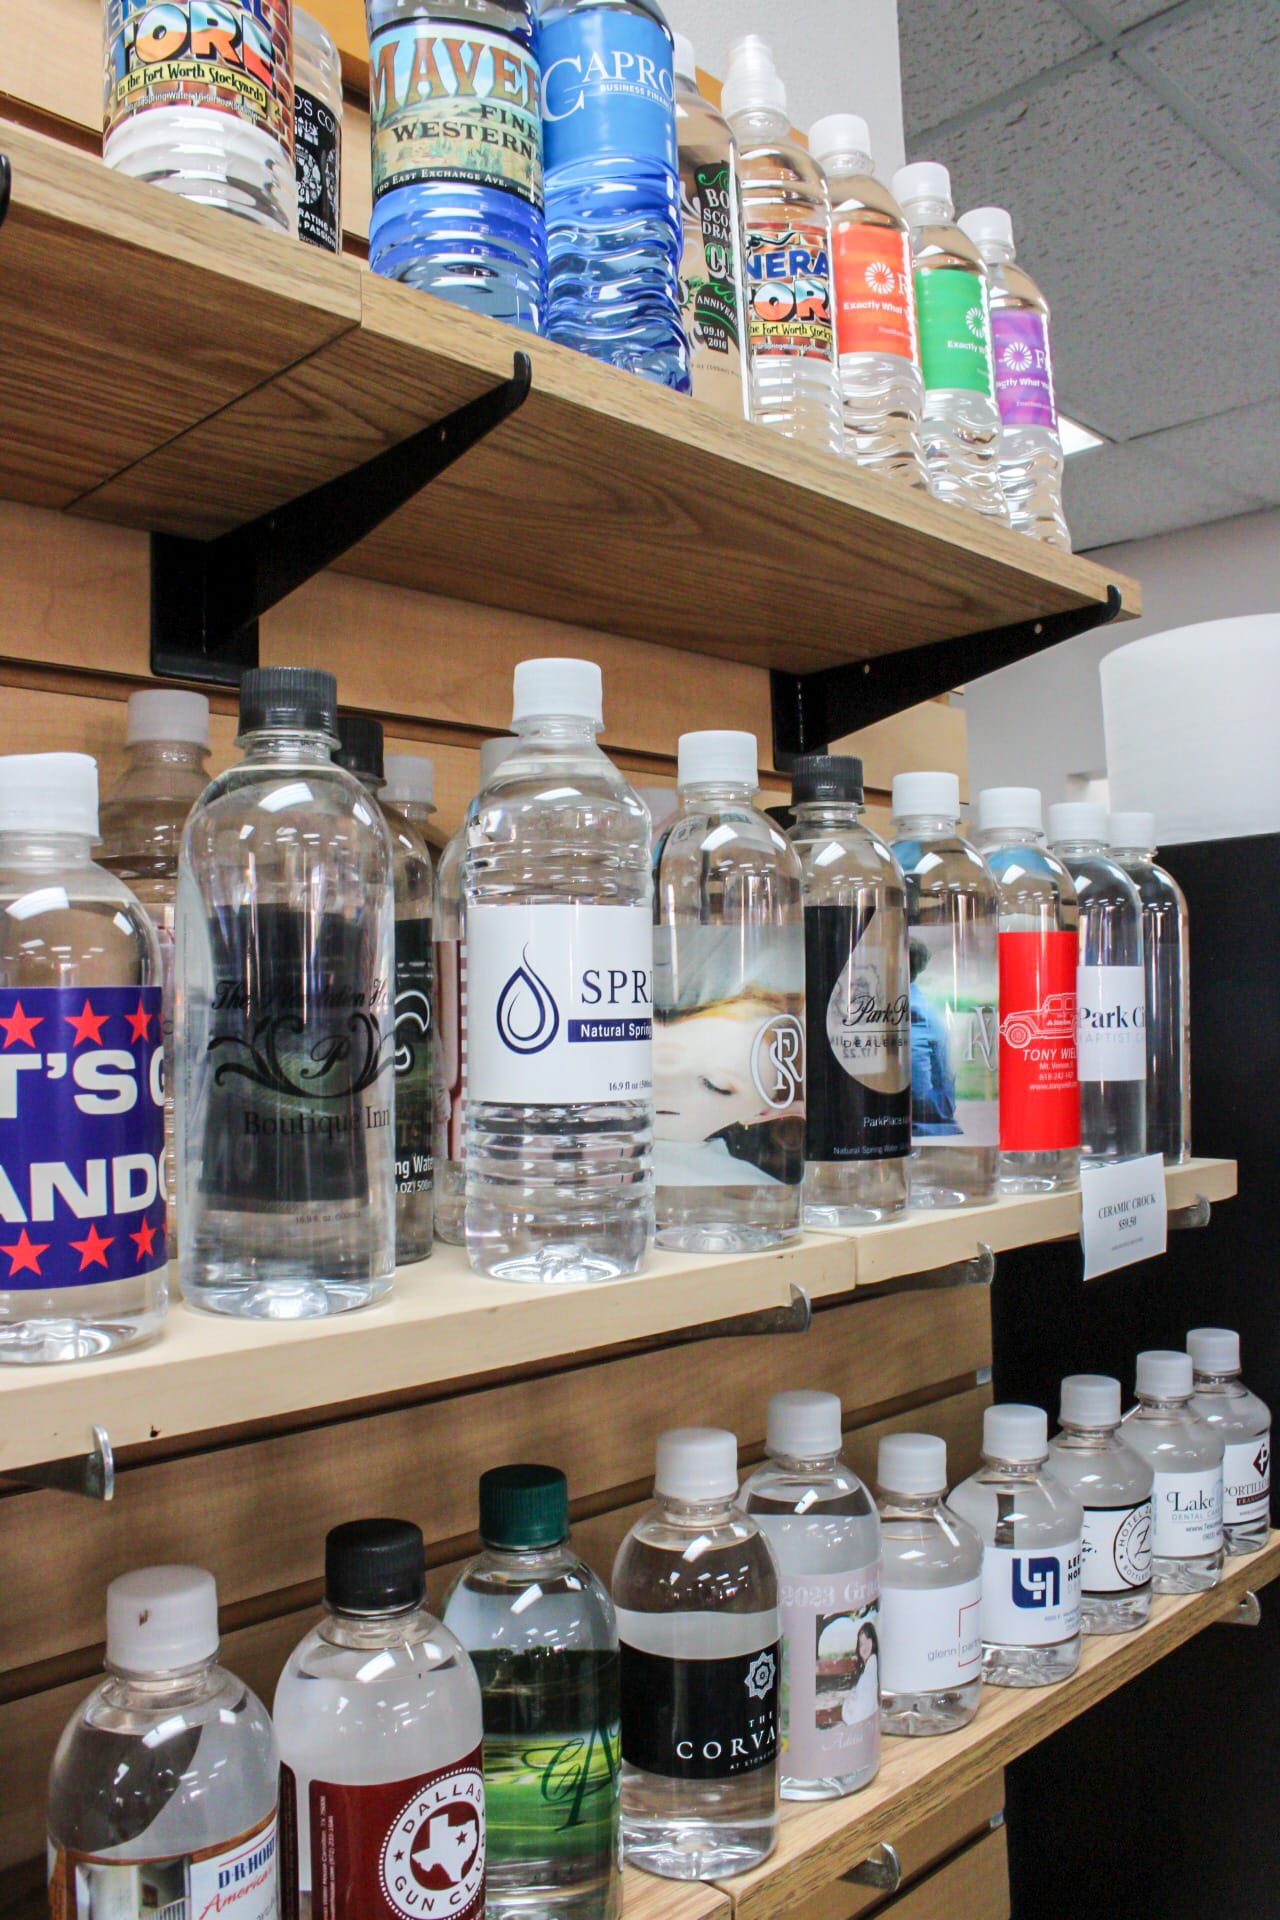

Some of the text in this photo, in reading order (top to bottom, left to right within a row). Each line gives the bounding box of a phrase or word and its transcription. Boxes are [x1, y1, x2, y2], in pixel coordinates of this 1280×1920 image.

[143, 67, 164, 84] Fort
[168, 65, 205, 79] Worth
[209, 68, 267, 104] Stockyards
[581, 1022, 625, 1038] Natural
[1023, 1048, 1057, 1061] TONY
[1166, 1491, 1216, 1512] Lake
[1118, 1513, 1143, 1547] HOTEL
[927, 1645, 957, 1662] glenn
[402, 1783, 482, 1834] DALLAS
[394, 1875, 435, 1911] GUN
